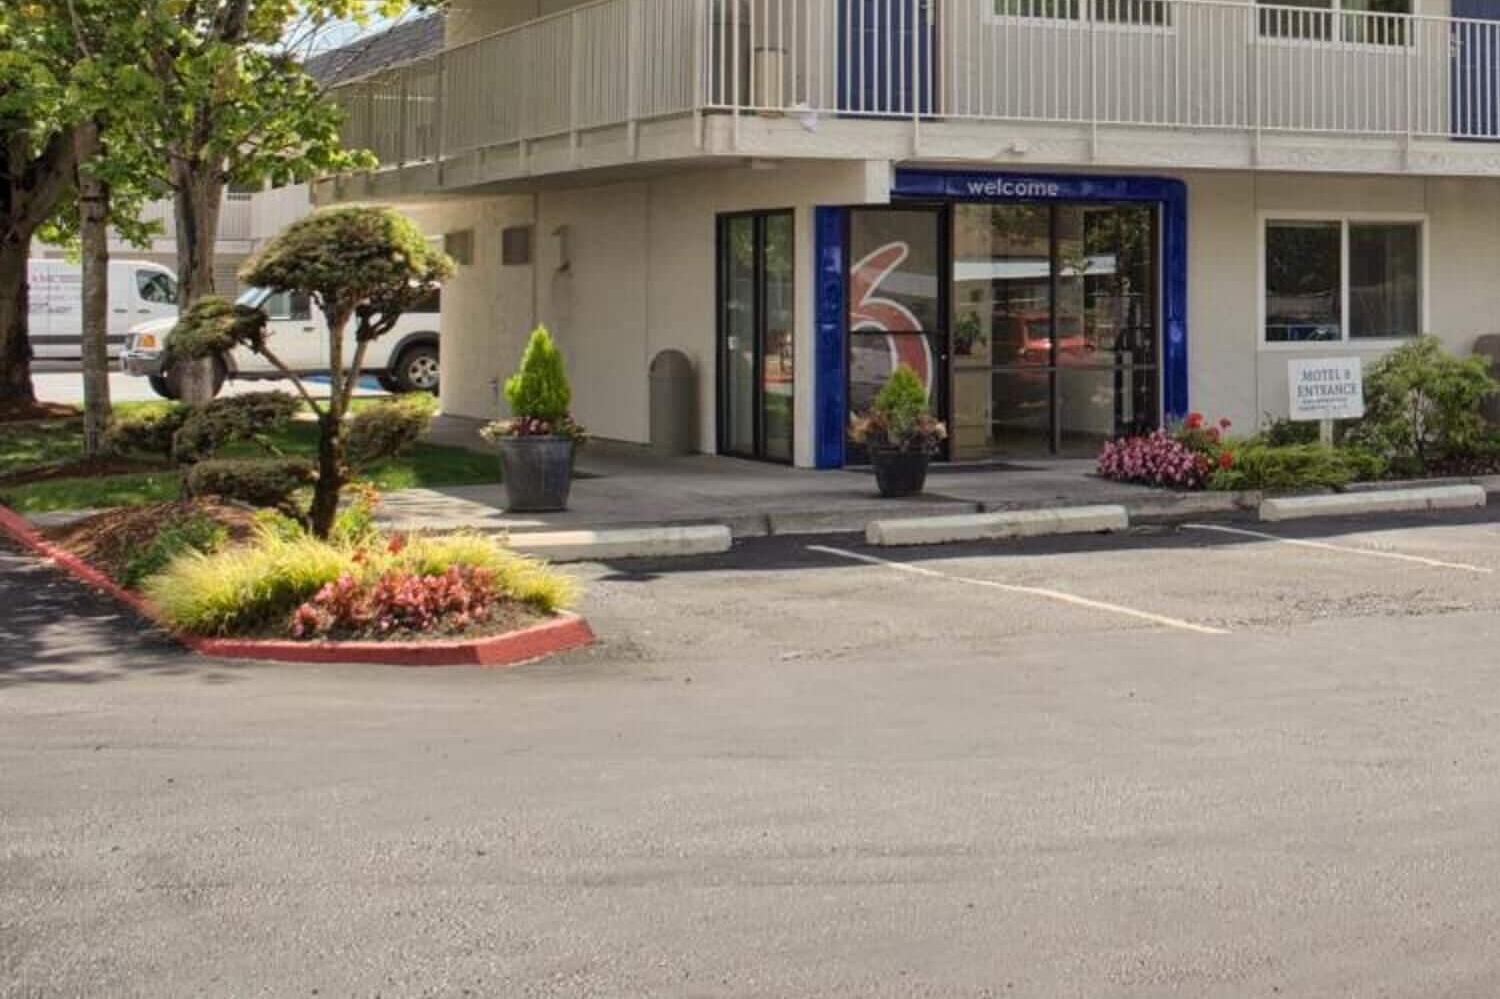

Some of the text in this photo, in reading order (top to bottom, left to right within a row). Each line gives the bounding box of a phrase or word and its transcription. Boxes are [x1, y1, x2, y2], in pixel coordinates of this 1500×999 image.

[967, 178, 1057, 196] welcome
[1302, 368, 1342, 381] MOTEL
[1297, 383, 1357, 398] ENTRANCE
